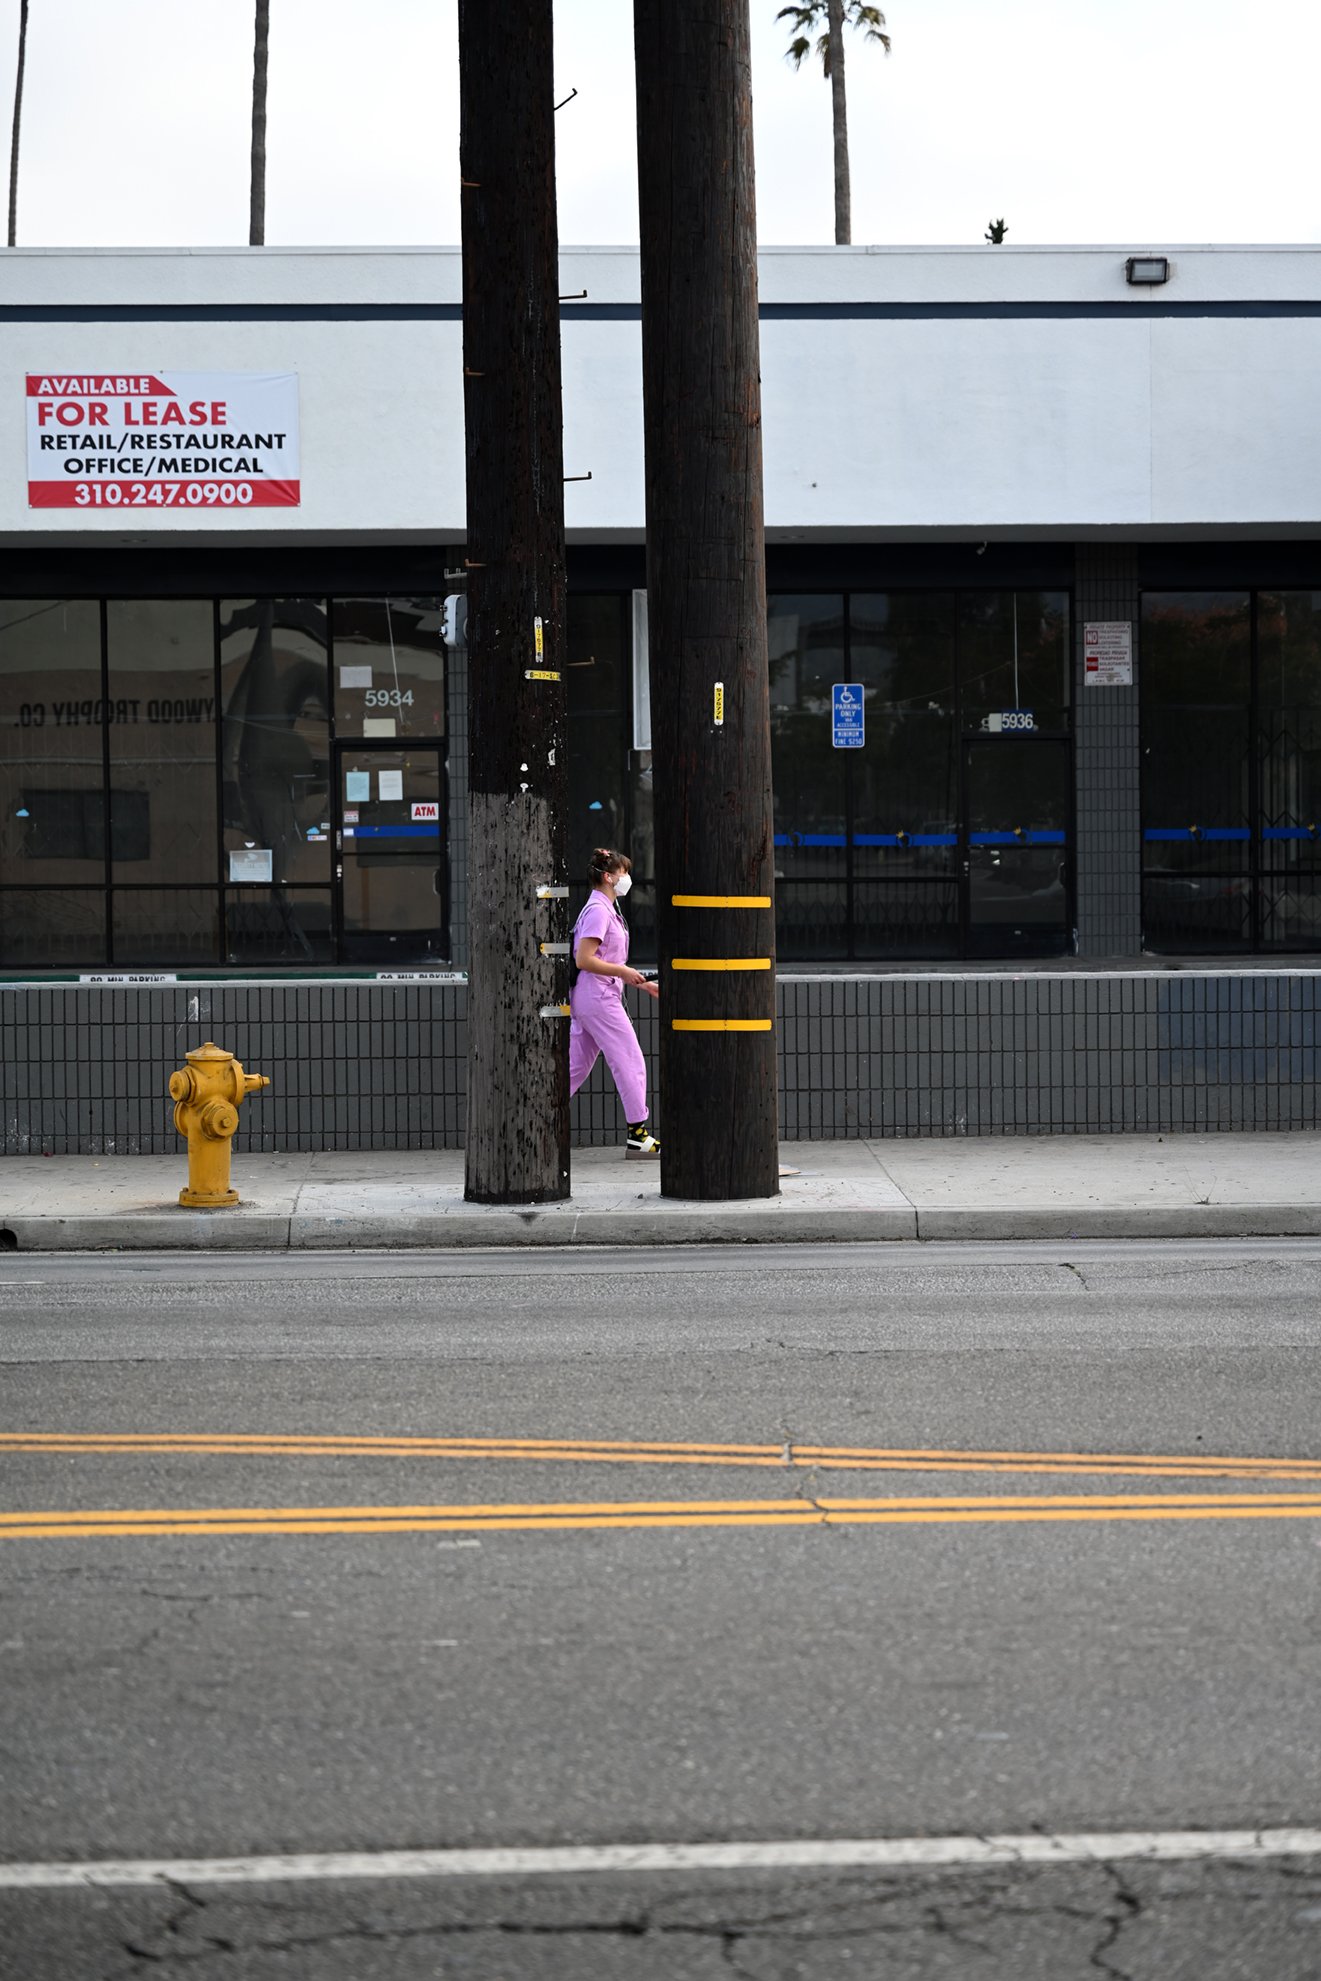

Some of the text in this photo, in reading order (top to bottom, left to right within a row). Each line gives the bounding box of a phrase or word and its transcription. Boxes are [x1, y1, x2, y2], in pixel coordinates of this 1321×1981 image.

[37, 378, 150, 395] AVAILABLE
[38, 401, 227, 427] FOR LEASE
[40, 433, 287, 453] RETAIL/RESTAURANT
[63, 456, 264, 477] OFFICE/MEDICAL
[74, 483, 253, 505] 310.247.0900
[1086, 631, 1098, 644] NO
[364, 690, 414, 707] 5934
[1002, 713, 1034, 729] 5936
[414, 806, 436, 817] ATM
